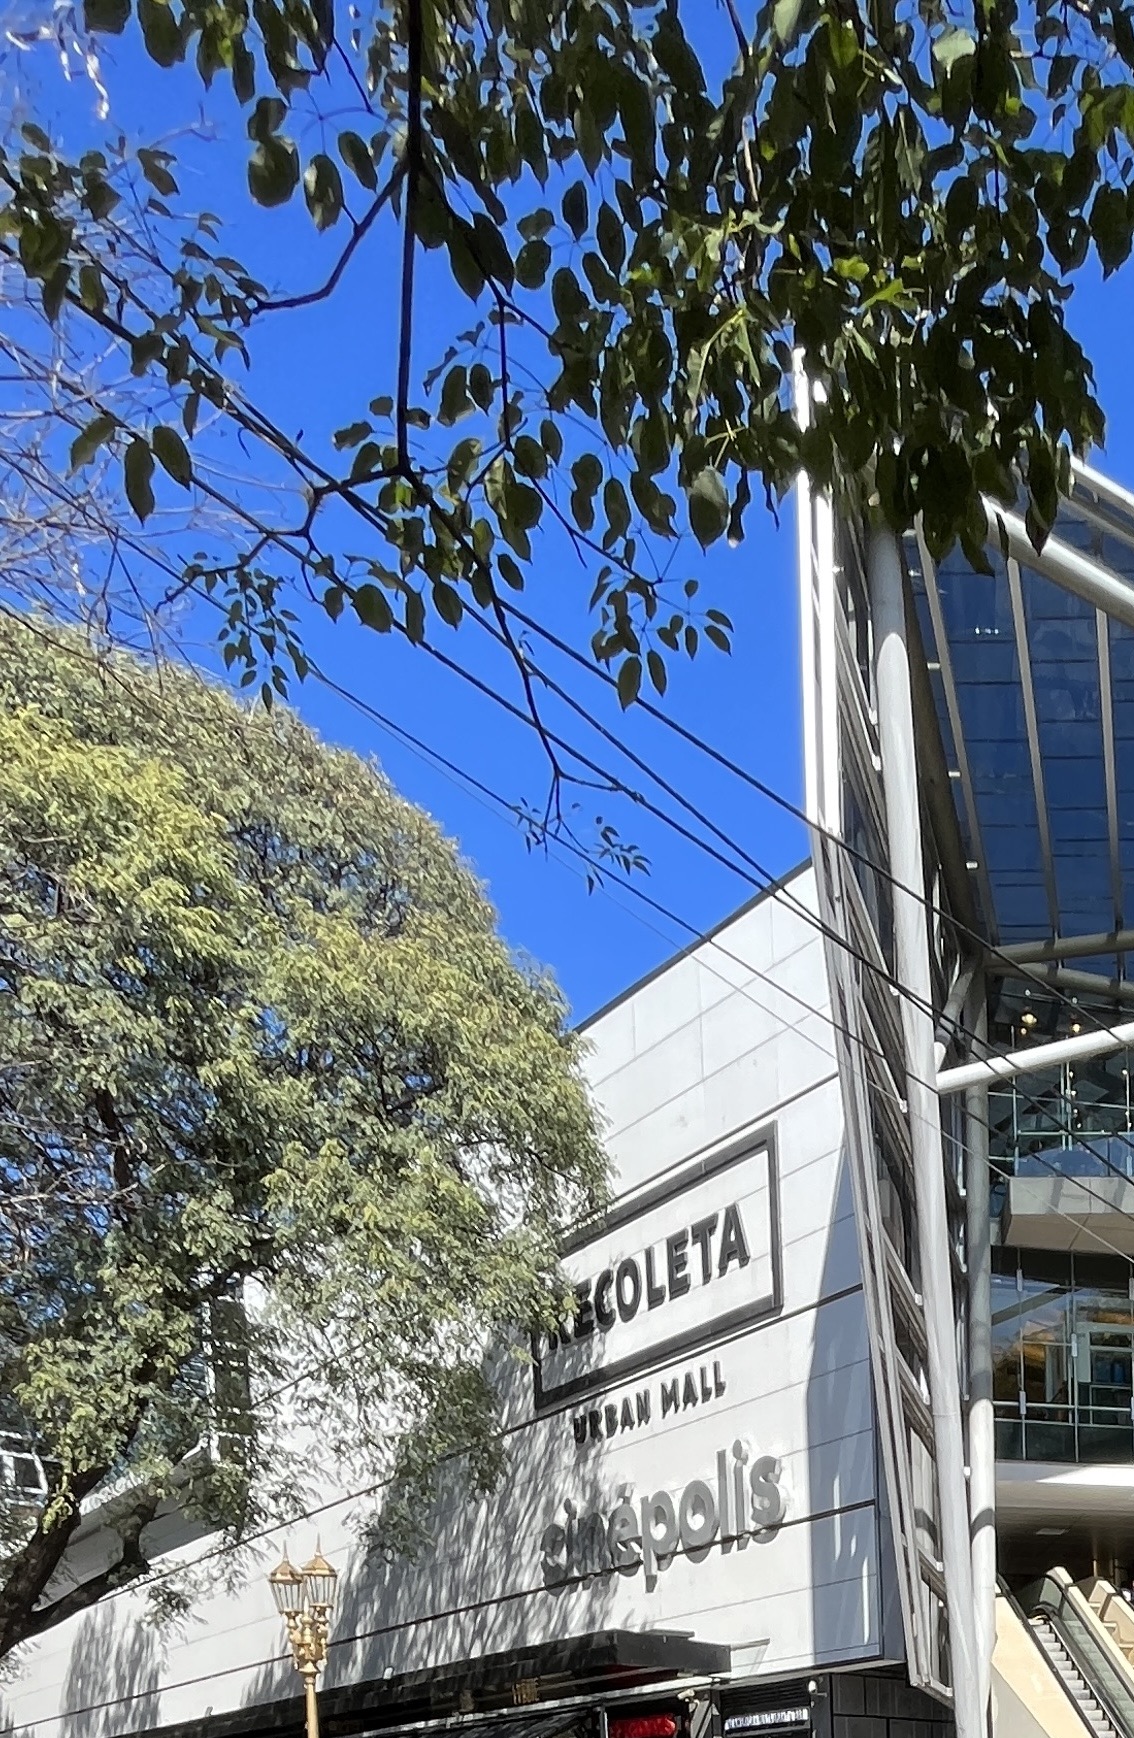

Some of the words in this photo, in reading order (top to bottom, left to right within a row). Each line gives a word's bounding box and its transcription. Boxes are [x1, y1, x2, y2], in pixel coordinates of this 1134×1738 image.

[573, 1388, 651, 1444] URBAN
[660, 1360, 727, 1419] MALL
[541, 1439, 787, 1597] cinépolis
